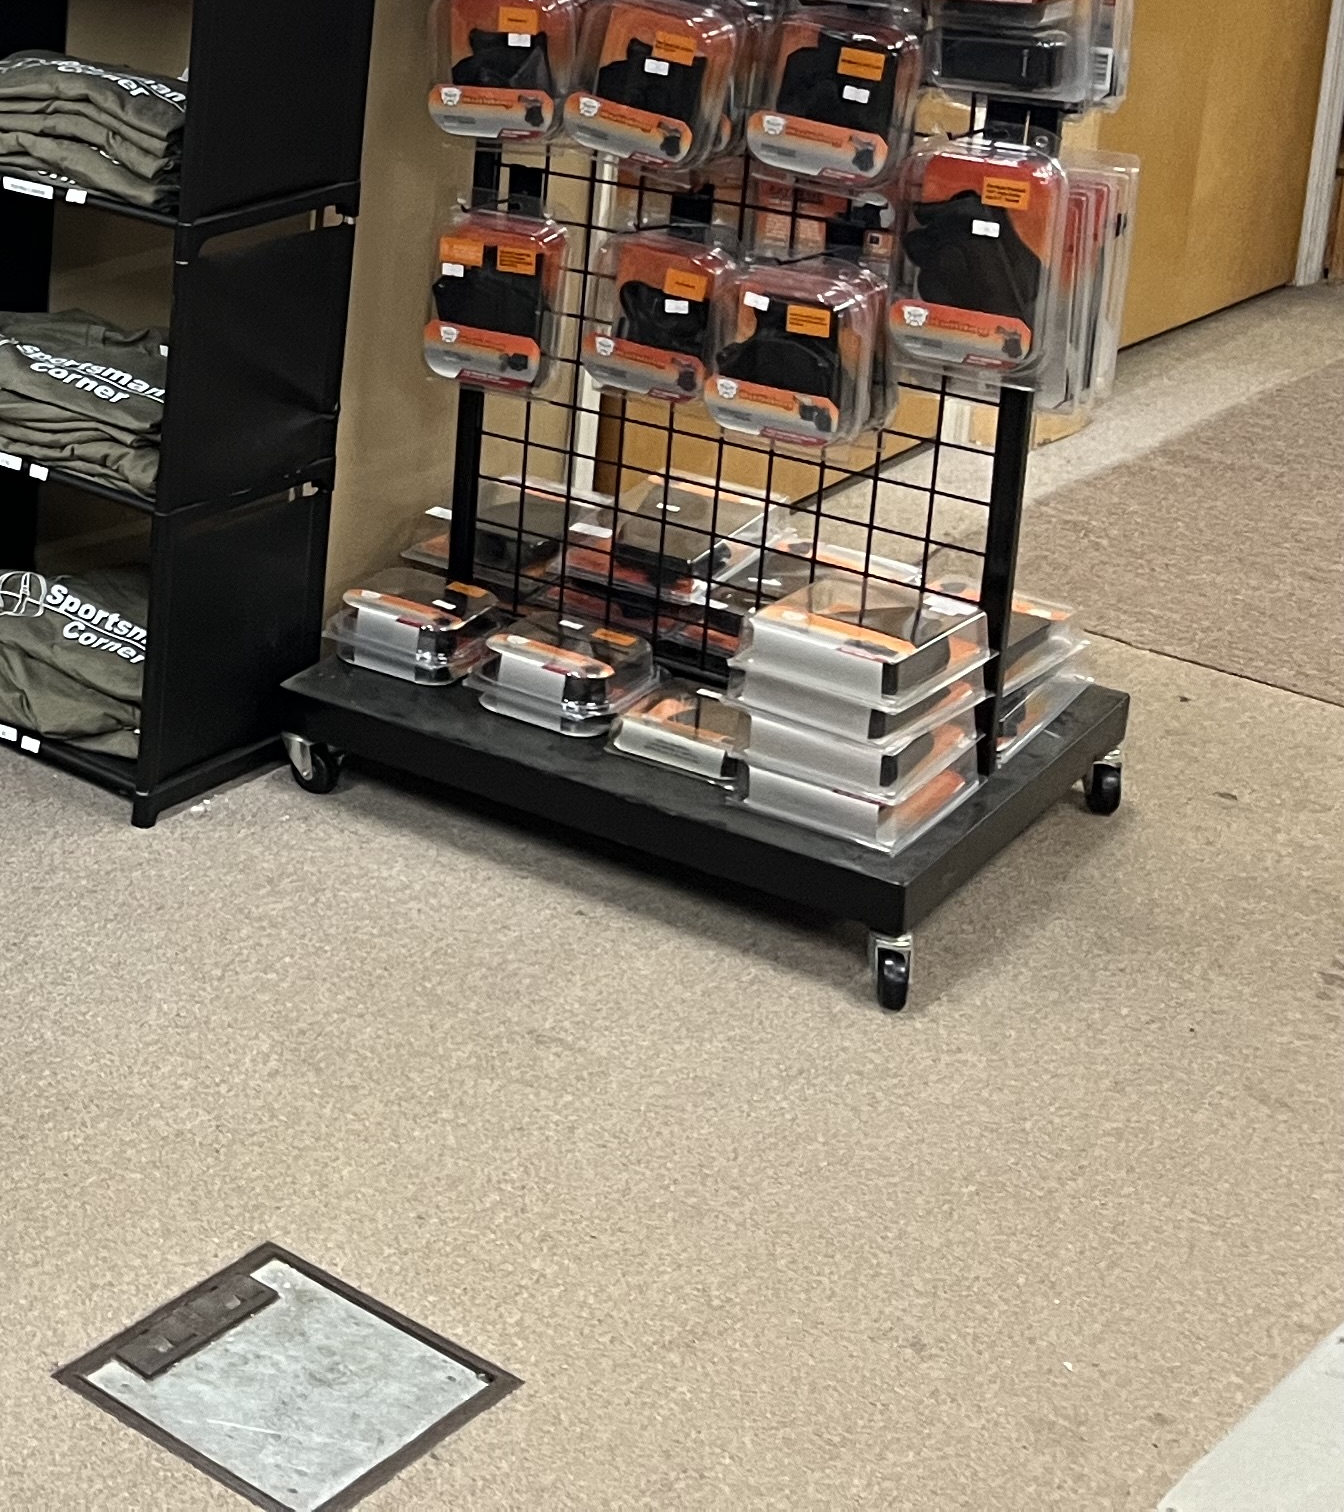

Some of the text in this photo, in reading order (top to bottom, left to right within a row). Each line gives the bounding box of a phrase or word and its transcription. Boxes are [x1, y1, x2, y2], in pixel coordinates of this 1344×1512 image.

[17, 345, 165, 399] Sportsman
[30, 361, 130, 404] Corner
[46, 584, 147, 645] Sportsm
[63, 620, 146, 664] Corner
